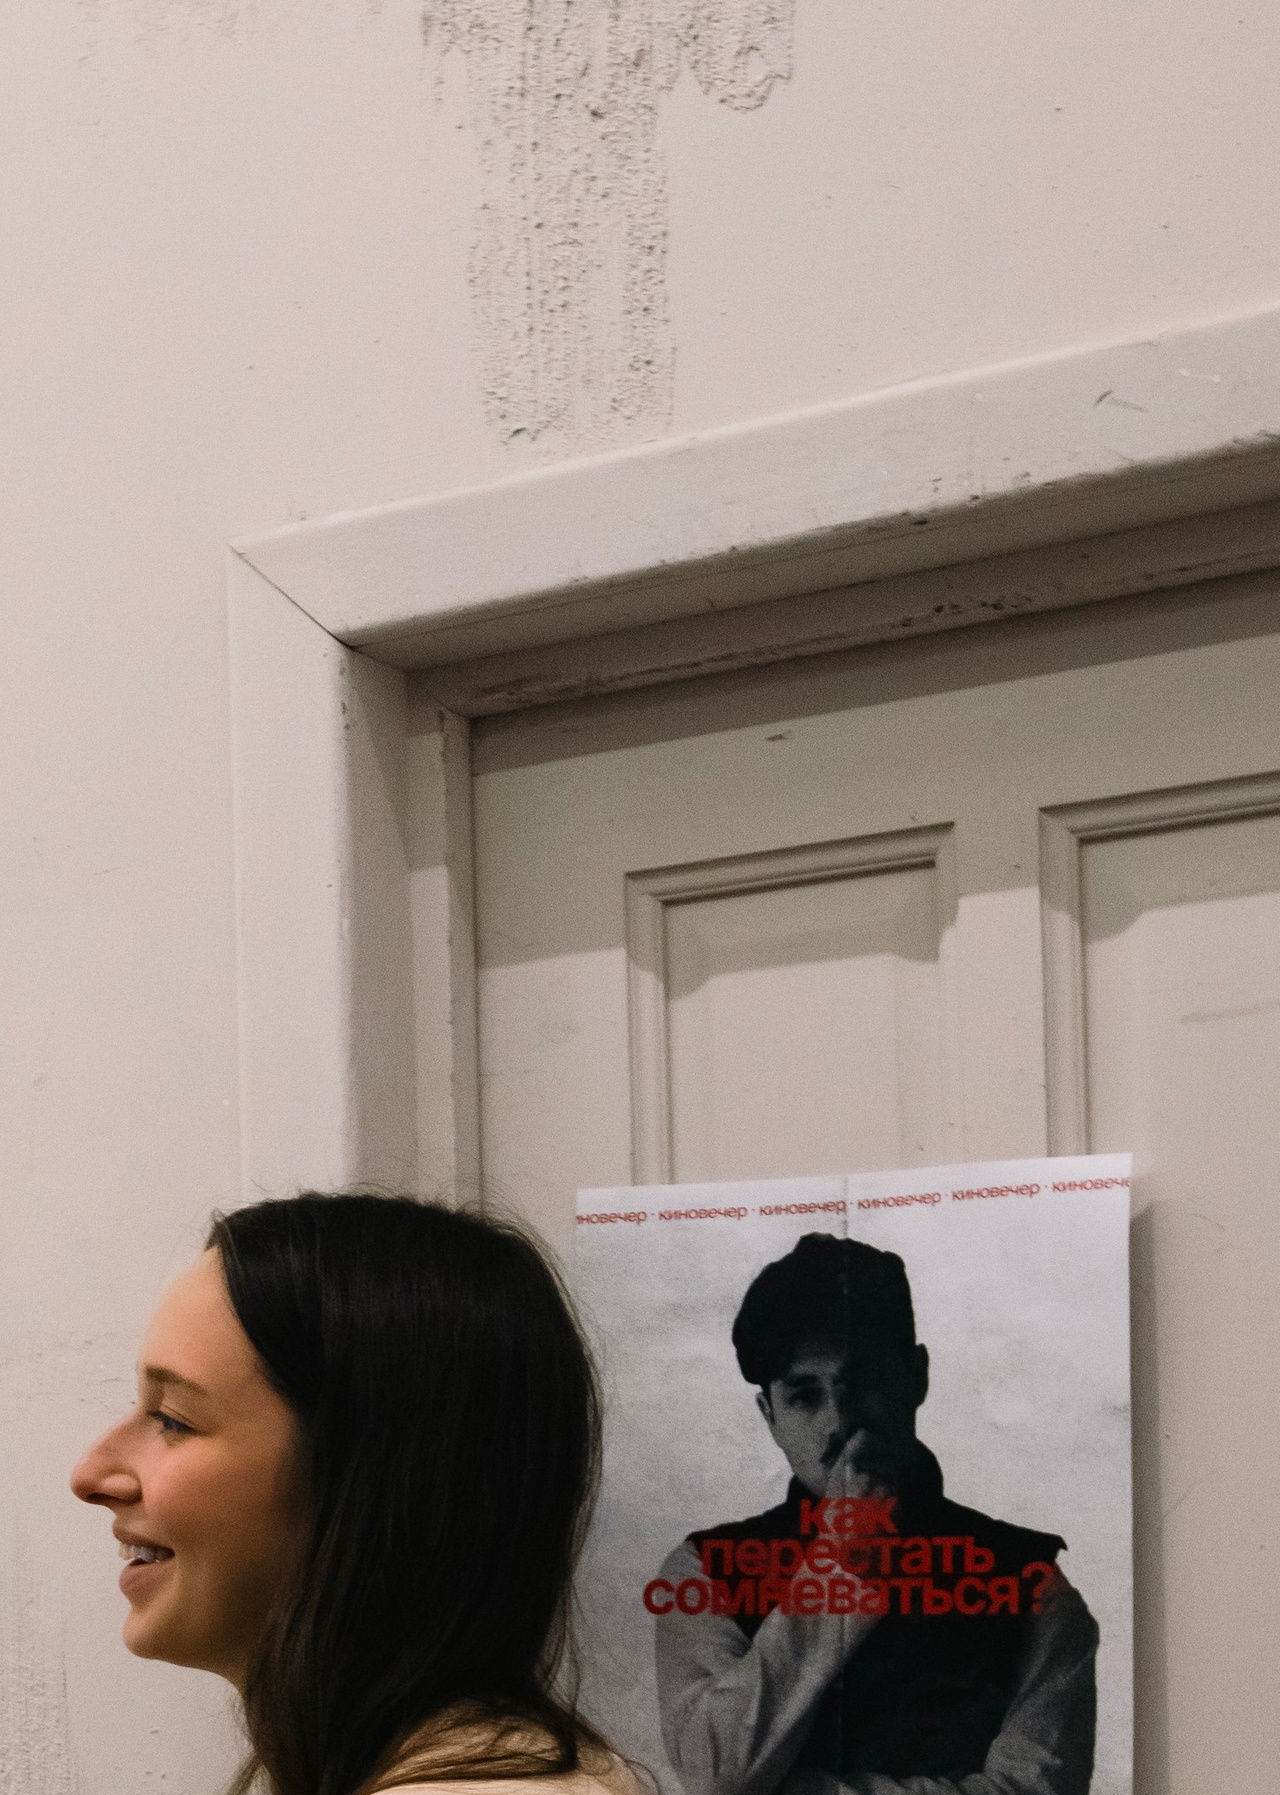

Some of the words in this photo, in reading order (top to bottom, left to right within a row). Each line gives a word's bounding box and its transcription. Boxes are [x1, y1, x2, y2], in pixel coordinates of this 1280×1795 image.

[658, 1206, 748, 1221] киновечер
[759, 1199, 847, 1216] киновечер
[857, 1191, 941, 1210] киновечер
[952, 1183, 1041, 1202] киновечер
[800, 1496, 898, 1535] как
[700, 1535, 995, 1580] перестать
[642, 1562, 1057, 1616] сомневаться?
